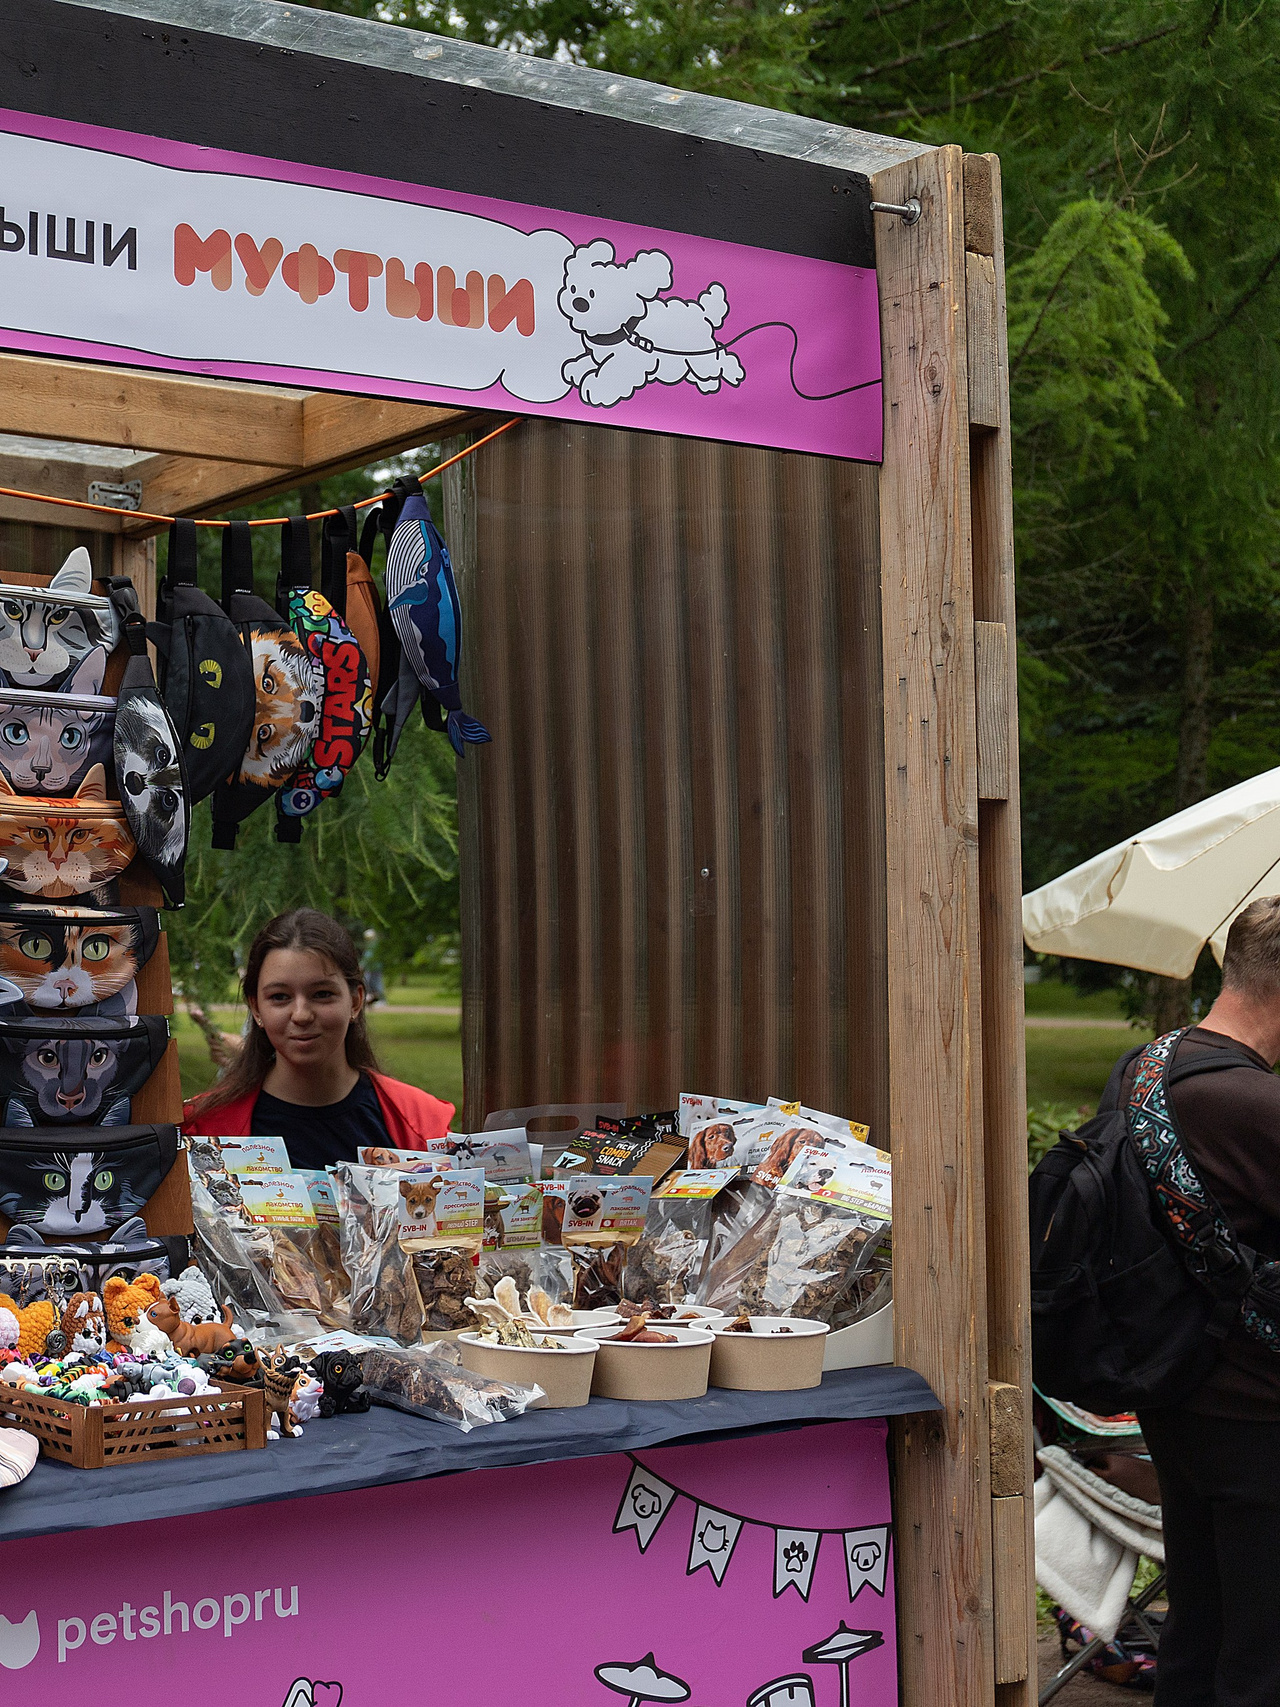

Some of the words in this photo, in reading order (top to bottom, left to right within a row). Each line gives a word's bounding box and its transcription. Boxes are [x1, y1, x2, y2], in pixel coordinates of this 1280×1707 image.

[174, 223, 535, 337] МУФТЫШИ
[314, 641, 361, 768] STARS
[681, 1097, 703, 1106] SVB-IN
[599, 1146, 631, 1160] COMBO
[804, 1148, 829, 1158] SVB-IN
[595, 1154, 626, 1168] SNACK
[402, 1224, 427, 1233] SVB-IN
[568, 1220, 594, 1228] SVB-IN
[57, 1585, 300, 1663] petshopru
